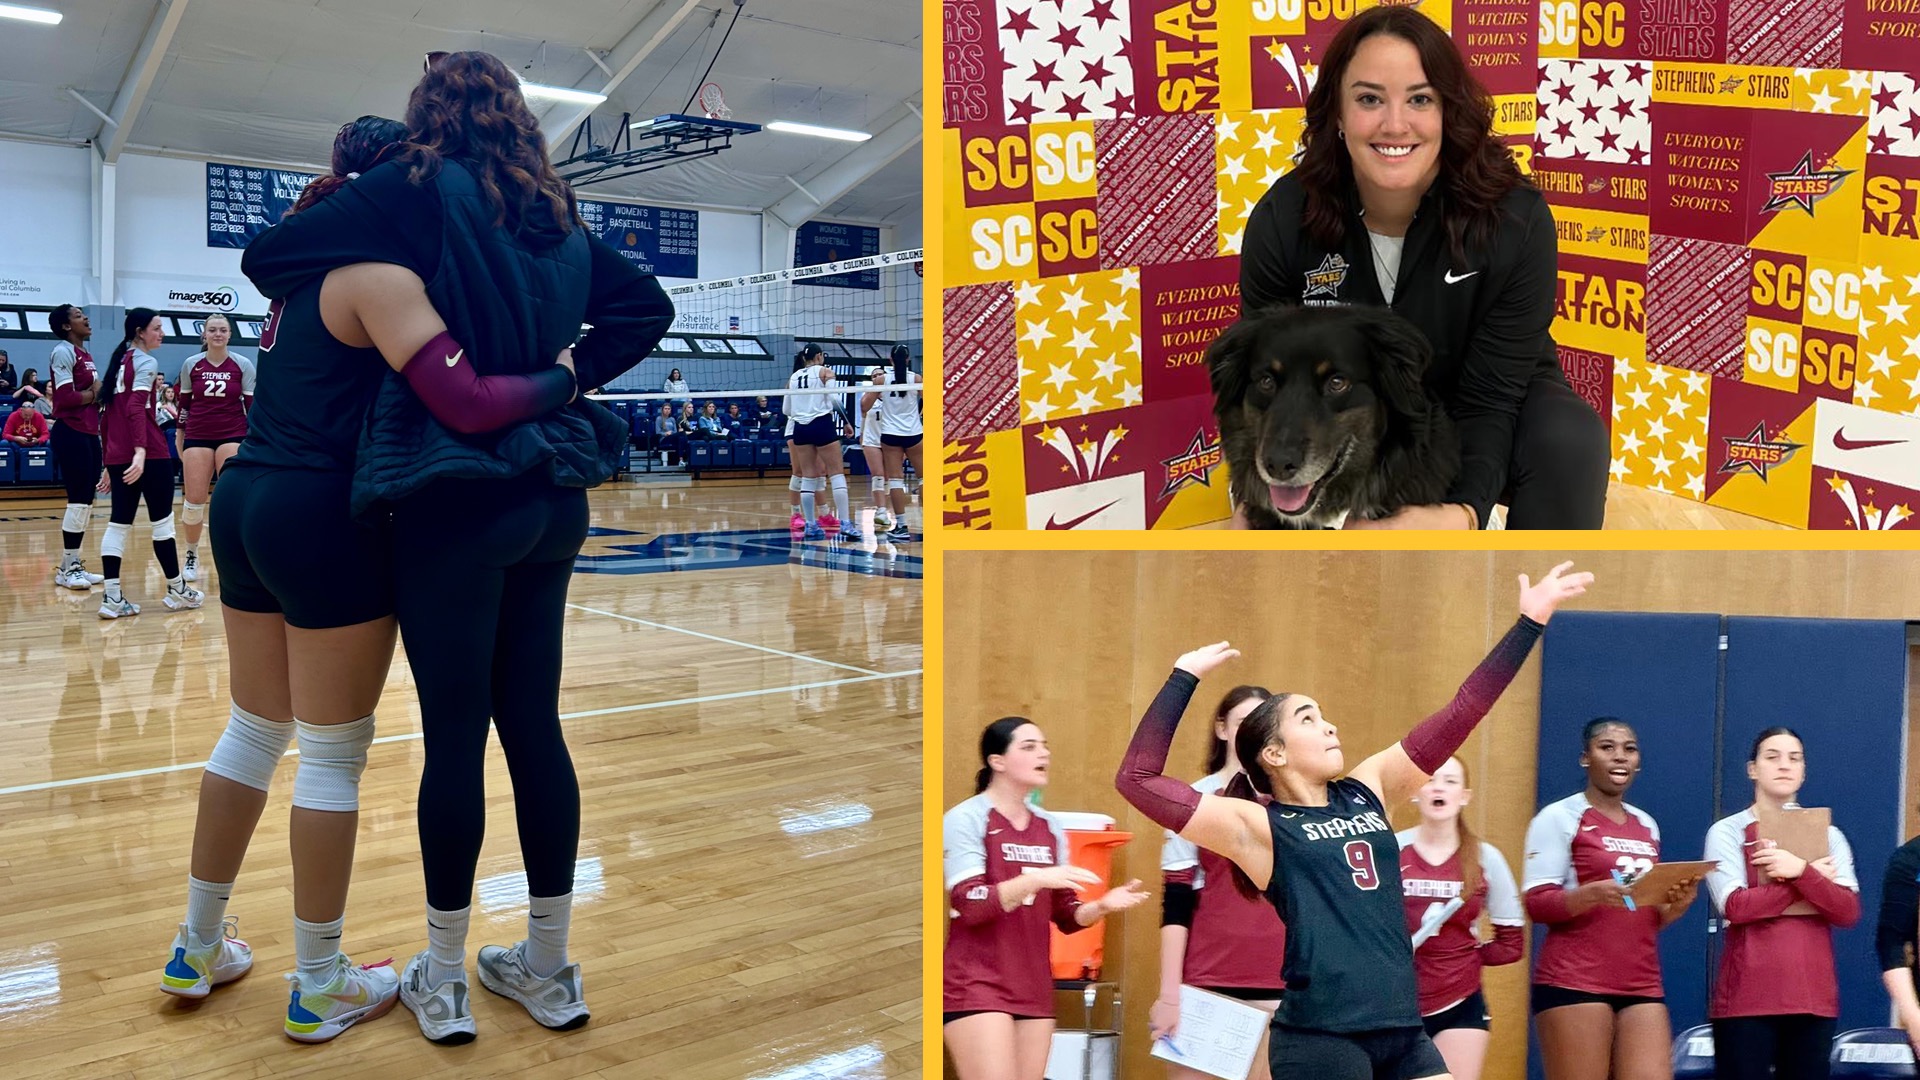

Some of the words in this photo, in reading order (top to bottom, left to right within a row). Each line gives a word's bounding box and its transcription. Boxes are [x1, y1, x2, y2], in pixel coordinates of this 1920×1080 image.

[1467, 12, 1528, 26] WATCHES
[1538, 1, 1576, 46] SC
[1582, 2, 1625, 47] SC
[1867, 21, 1920, 38] SPOR
[1467, 32, 1528, 47] WOMEN'S
[1637, 25, 1715, 60] STARS
[1739, 15, 1782, 54] STEPHENS
[1469, 52, 1522, 67] SPORTS.
[1655, 69, 1715, 94] STEPHENS
[1748, 74, 1790, 99] STARS
[1501, 101, 1533, 123] STARS
[1096, 127, 1139, 170] STEPHENS
[1169, 125, 1210, 168] STEPHENS
[1664, 132, 1745, 151] EVERYONE
[965, 135, 1029, 191] SC
[1035, 131, 1095, 186] SC
[1668, 153, 1740, 172] WATCHES
[210, 167, 224, 176] 1987
[247, 182, 262, 191] 1996
[1610, 176, 1647, 201] STARS
[1668, 174, 1740, 193] WOMEN'S
[1773, 180, 1828, 195] STARS
[210, 189, 225, 199] 2000
[247, 193, 262, 202] 2002
[210, 201, 225, 210] 2006
[229, 203, 243, 211] 2007
[1670, 194, 1733, 213] SPORTS.
[210, 212, 226, 221] 2012
[229, 214, 245, 222] 2013
[247, 214, 262, 224] 2015
[615, 206, 648, 217] WOMEN'S
[1114, 214, 1156, 258] STEPHENS
[1153, 176, 1189, 214] COLLEGE
[210, 222, 227, 232] 2022
[229, 224, 245, 233] 2023
[609, 218, 653, 230] BASKETBALL
[819, 224, 847, 235] WOMEN'S
[1040, 208, 1098, 262] SC
[814, 236, 851, 247] BASKETBALL
[970, 215, 1033, 270] SC
[1610, 226, 1646, 251] STARS
[1648, 246, 1684, 277] STEPHENS
[1706, 256, 1745, 289] STEPHENS
[671, 286, 694, 295] COLUMBIA
[708, 280, 733, 290] COLUMBIA
[750, 273, 777, 284] COLUMBIA
[794, 266, 824, 277] COLUMBIA
[843, 258, 875, 270] COLUMBIA
[1752, 258, 1803, 311] SC
[9, 285, 41, 293] Columbia
[168, 290, 232, 306] image360
[1156, 283, 1241, 306] EVERYONE
[1807, 268, 1861, 321] SC
[676, 320, 719, 331] Insurance
[682, 313, 714, 324] Shelter
[962, 293, 1009, 339] STEPHENS
[1161, 303, 1239, 327] WATCHES
[1655, 324, 1692, 354] STEPHENS
[1690, 299, 1724, 327] COLLEGE
[1747, 327, 1798, 378] SC
[1803, 338, 1855, 390] SC
[201, 371, 231, 381] STEPHENS
[945, 347, 987, 389] COLLEGE
[203, 380, 227, 397] 22
[797, 374, 809, 389] 11
[1169, 451, 1220, 478] STARS
[1730, 446, 1780, 462] STARS
[1301, 811, 1389, 841] STEPHENS
[1343, 839, 1380, 891] 9
